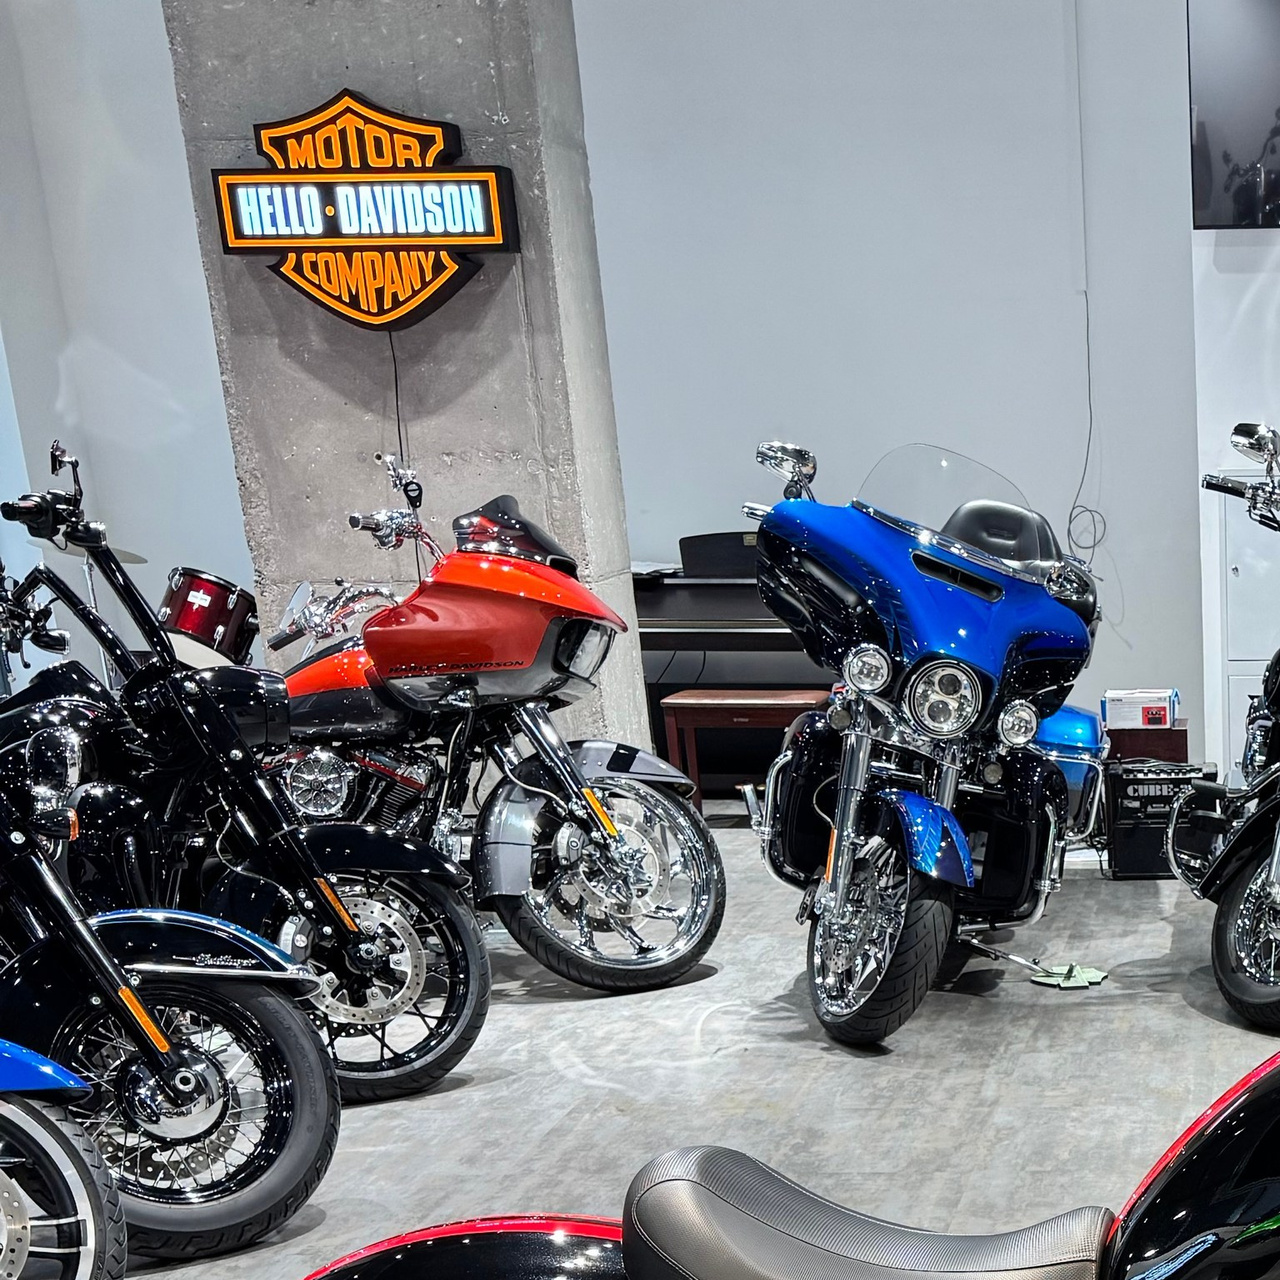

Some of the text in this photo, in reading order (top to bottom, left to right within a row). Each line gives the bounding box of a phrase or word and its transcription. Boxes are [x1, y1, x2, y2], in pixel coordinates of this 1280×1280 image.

[286, 112, 422, 169] MOTOR
[237, 184, 486, 236] HELLO DAVIDSON
[302, 251, 436, 313] COMPANY
